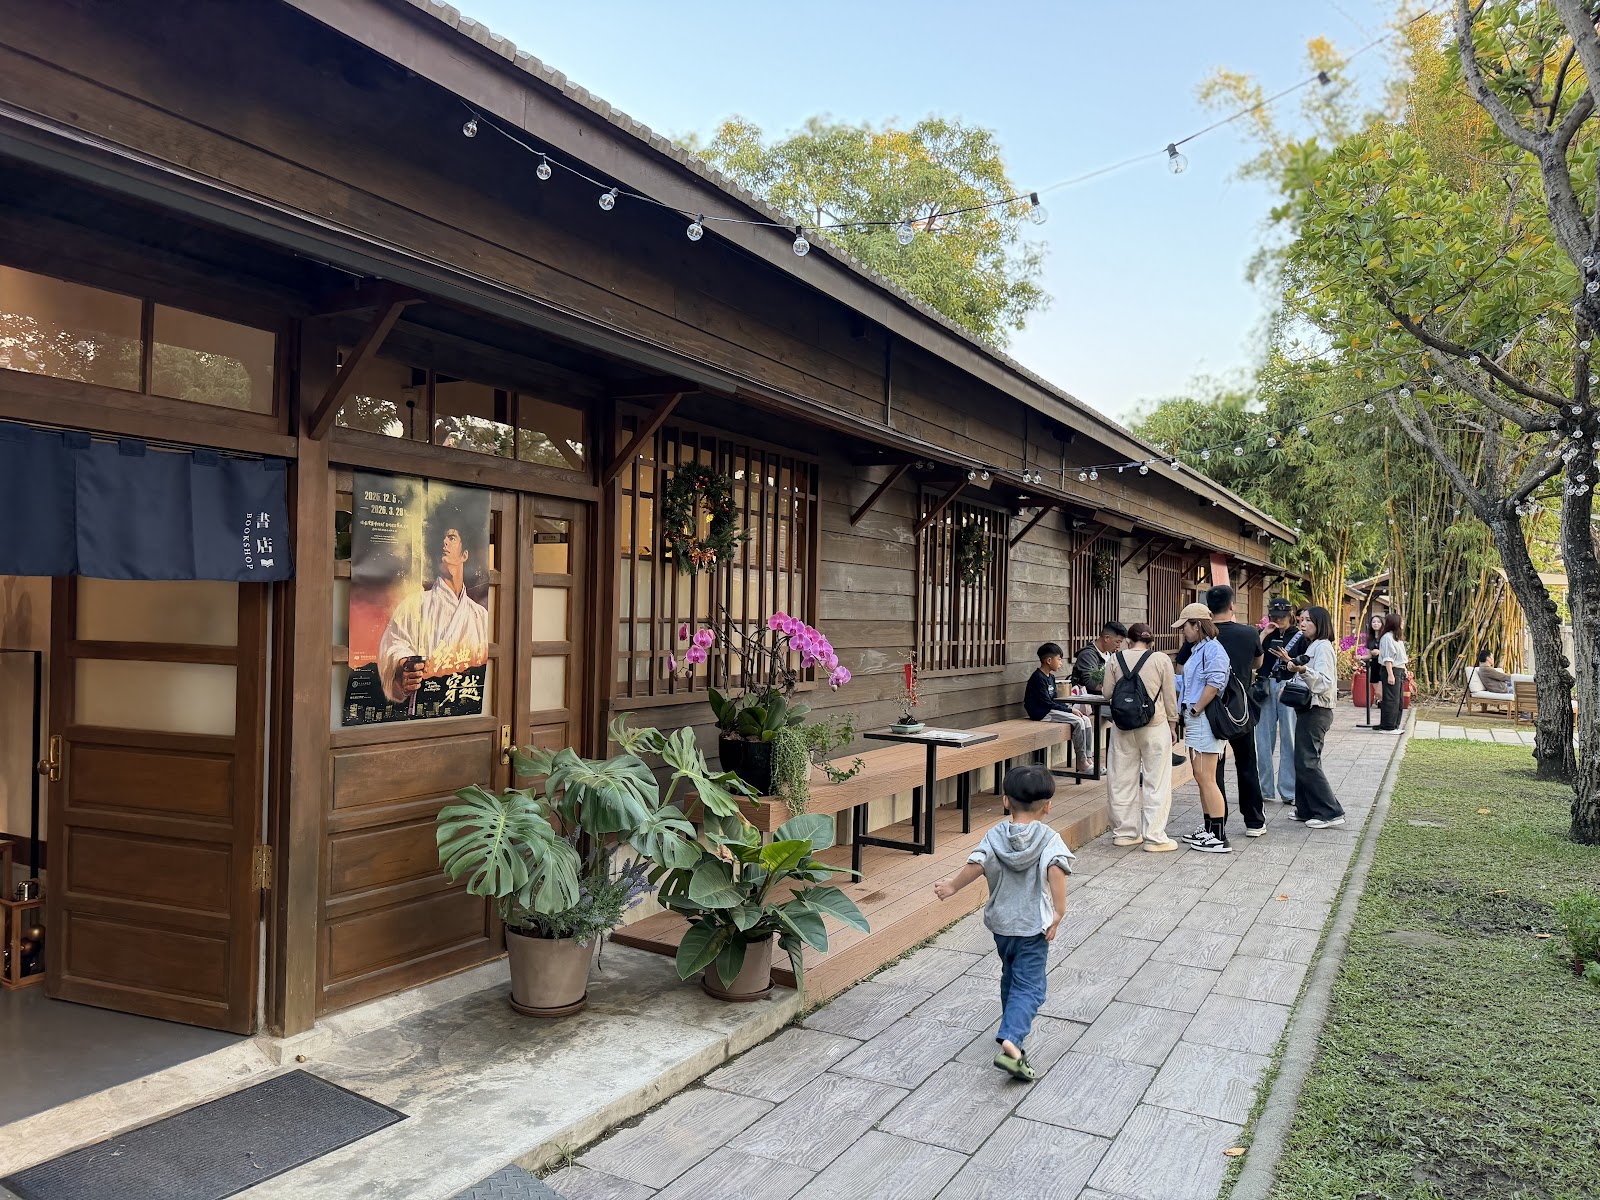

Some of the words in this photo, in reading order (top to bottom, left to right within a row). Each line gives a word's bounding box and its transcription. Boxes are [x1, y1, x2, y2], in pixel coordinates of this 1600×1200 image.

[242, 512, 254, 570] BOOKSHOP
[256, 511, 273, 554] 書店
[439, 672, 484, 706] 穿越
